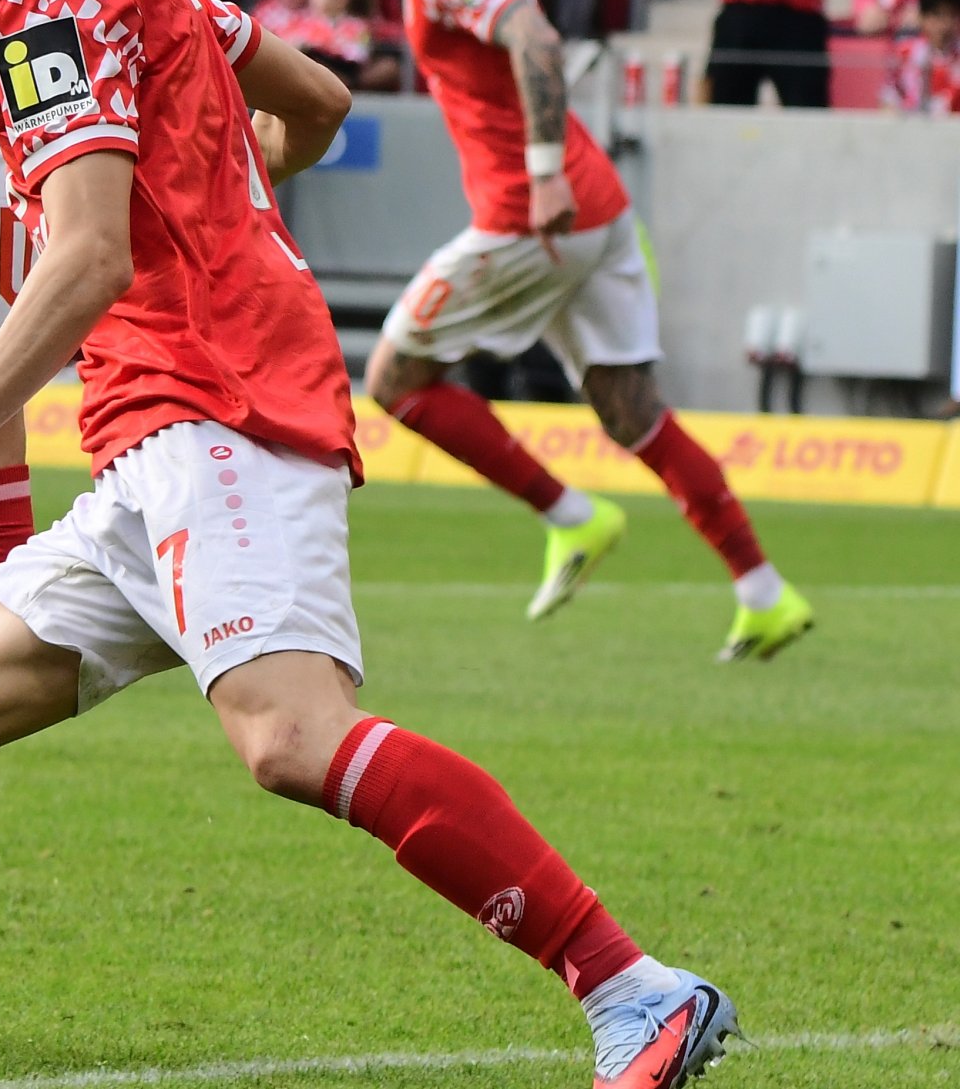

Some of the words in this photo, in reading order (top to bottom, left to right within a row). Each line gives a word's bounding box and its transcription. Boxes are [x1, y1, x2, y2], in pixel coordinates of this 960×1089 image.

[772, 436, 904, 476] LOTTO
[156, 528, 189, 636] 7
[202, 616, 254, 650] JAKO
